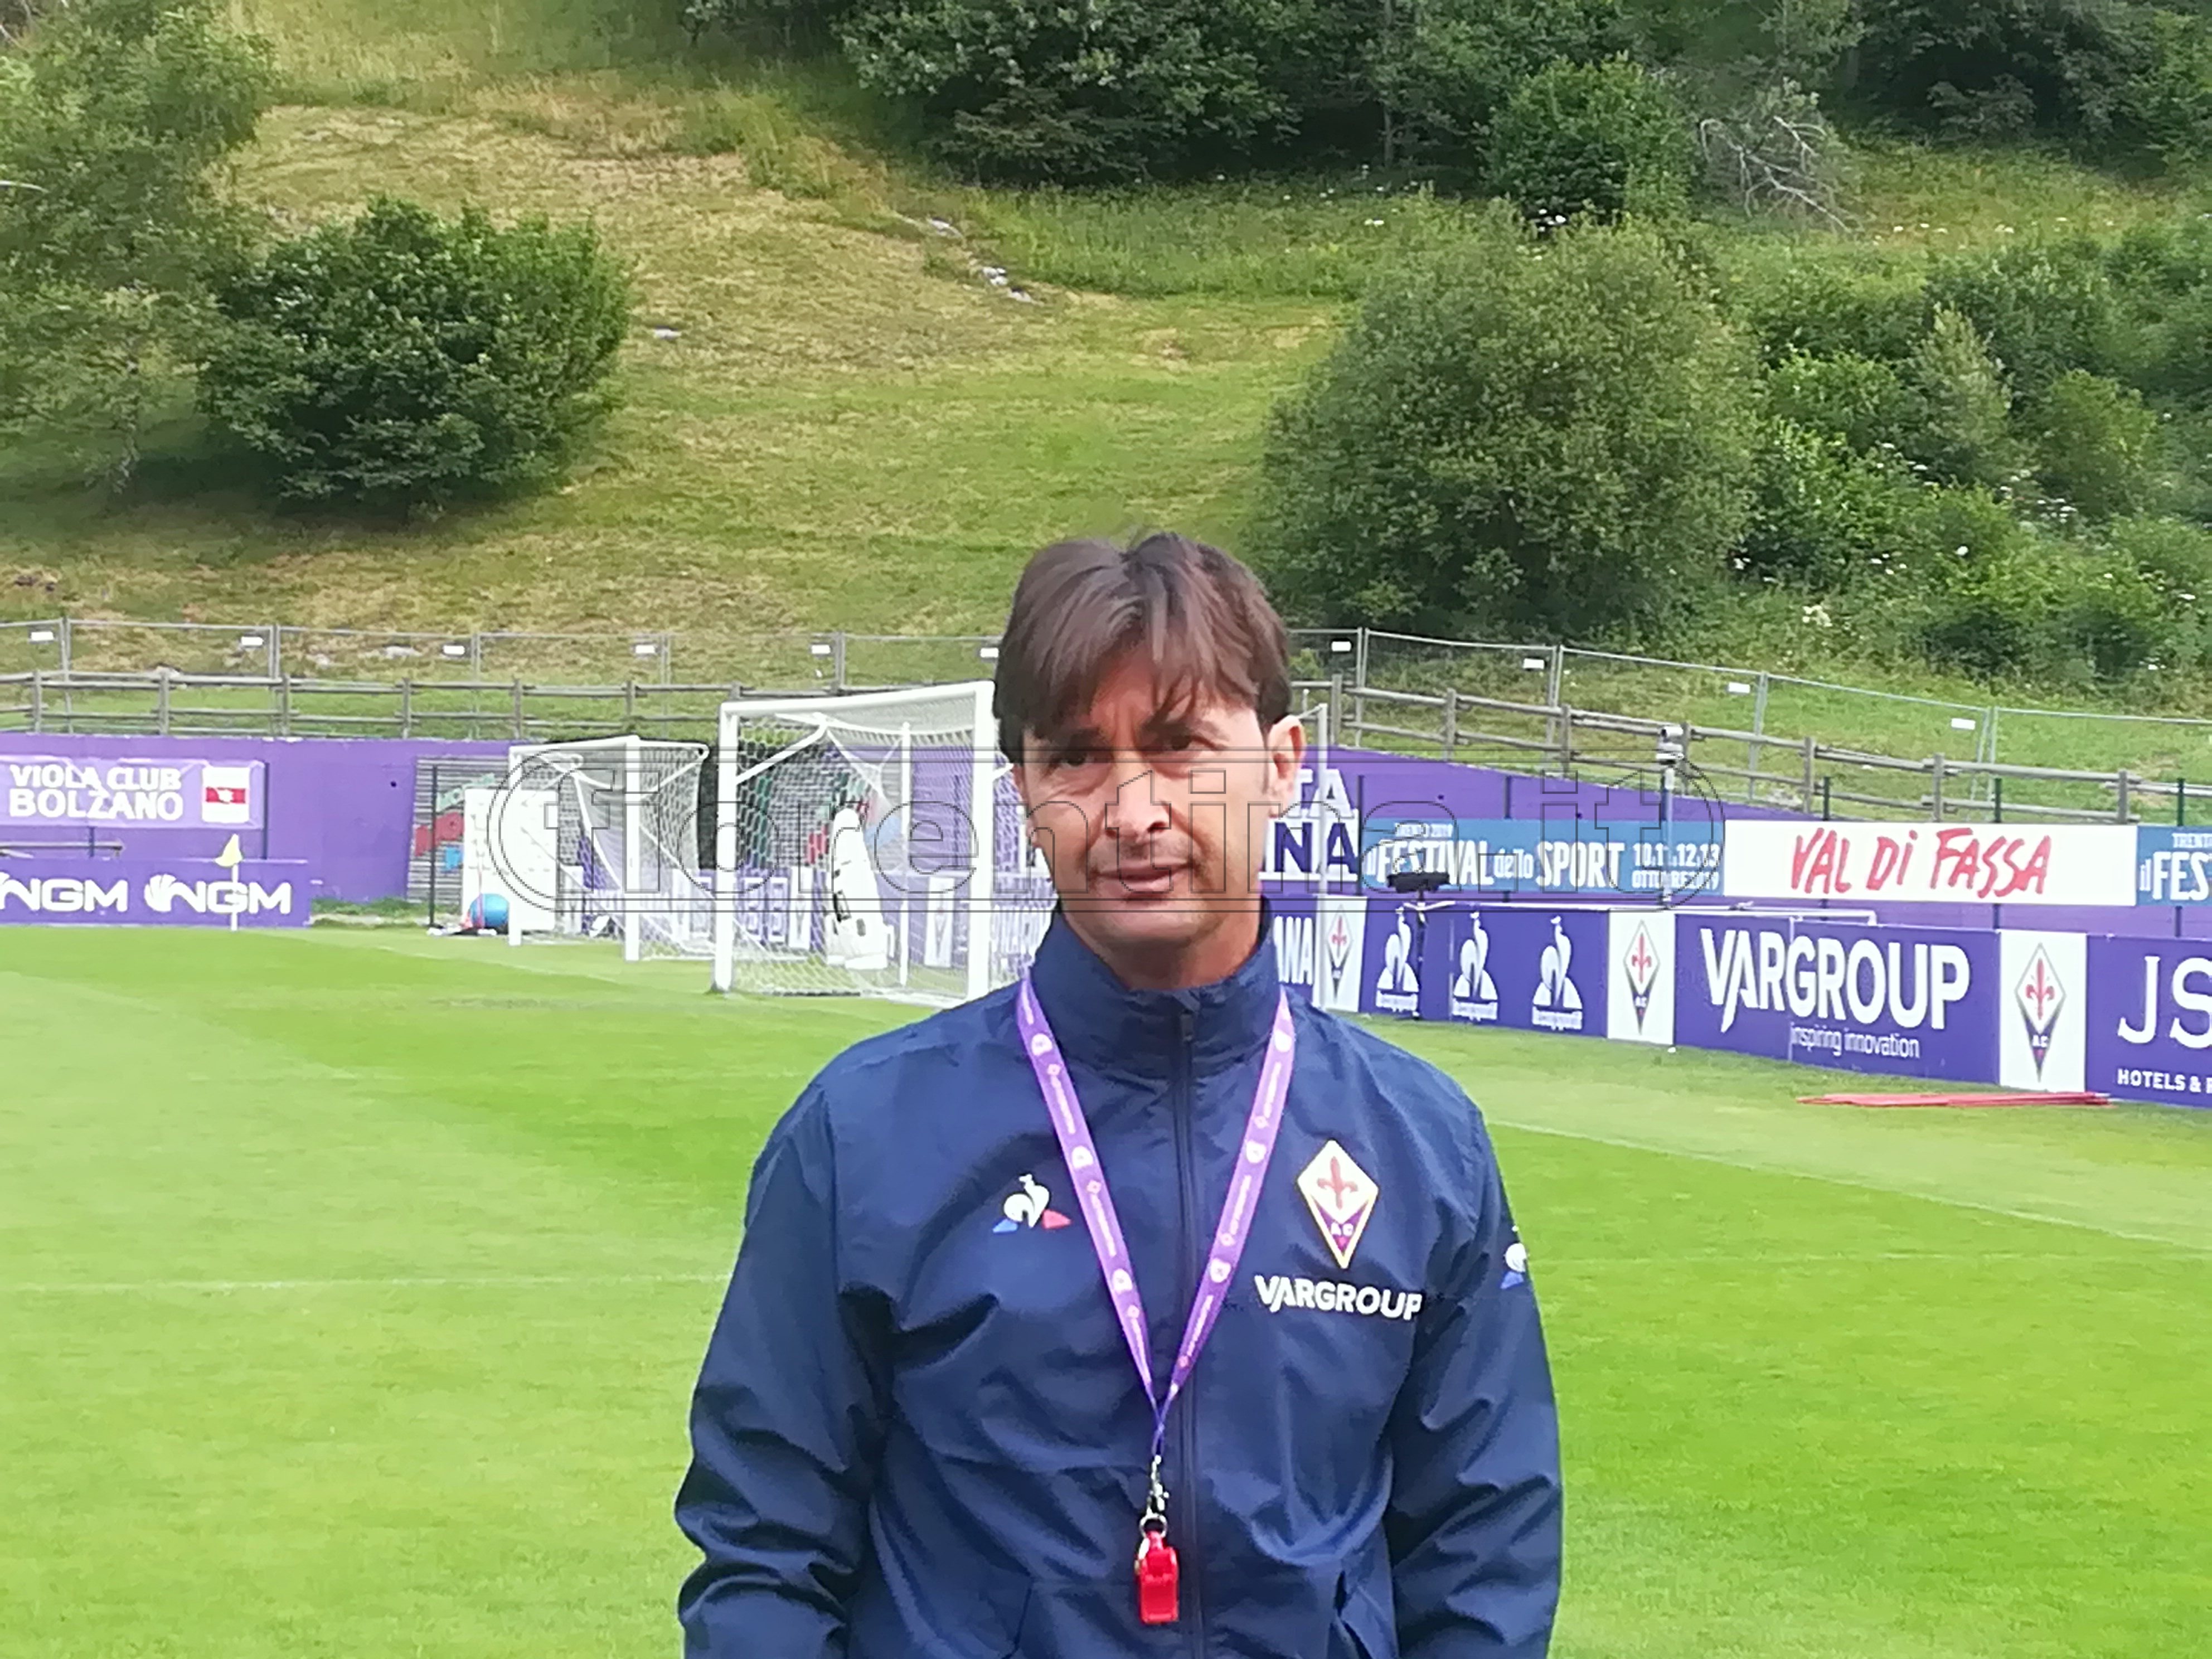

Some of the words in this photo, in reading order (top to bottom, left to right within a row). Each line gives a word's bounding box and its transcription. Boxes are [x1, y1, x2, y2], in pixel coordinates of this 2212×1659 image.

[9, 764, 99, 788] VIOLA
[106, 767, 182, 791] CLUB
[9, 788, 183, 821] BOLZANO
[1265, 821, 1358, 874] NA
[1376, 839, 1495, 885] FESTIVAL
[1535, 841, 1625, 888] SPORT
[1791, 827, 1852, 894] VAL
[1929, 827, 2051, 899] FASSA
[0, 877, 128, 913] NGM
[165, 880, 292, 914] NGM
[2152, 851, 2212, 901] FES
[1700, 928, 1971, 1033] VARGROUP
[1790, 1022, 1842, 1056] inspiring
[1843, 1027, 1920, 1059] innovation
[2117, 1068, 2186, 1092] HOTELS
[2189, 1075, 2202, 1093] &
[1254, 1274, 1423, 1321] VARGROUP
